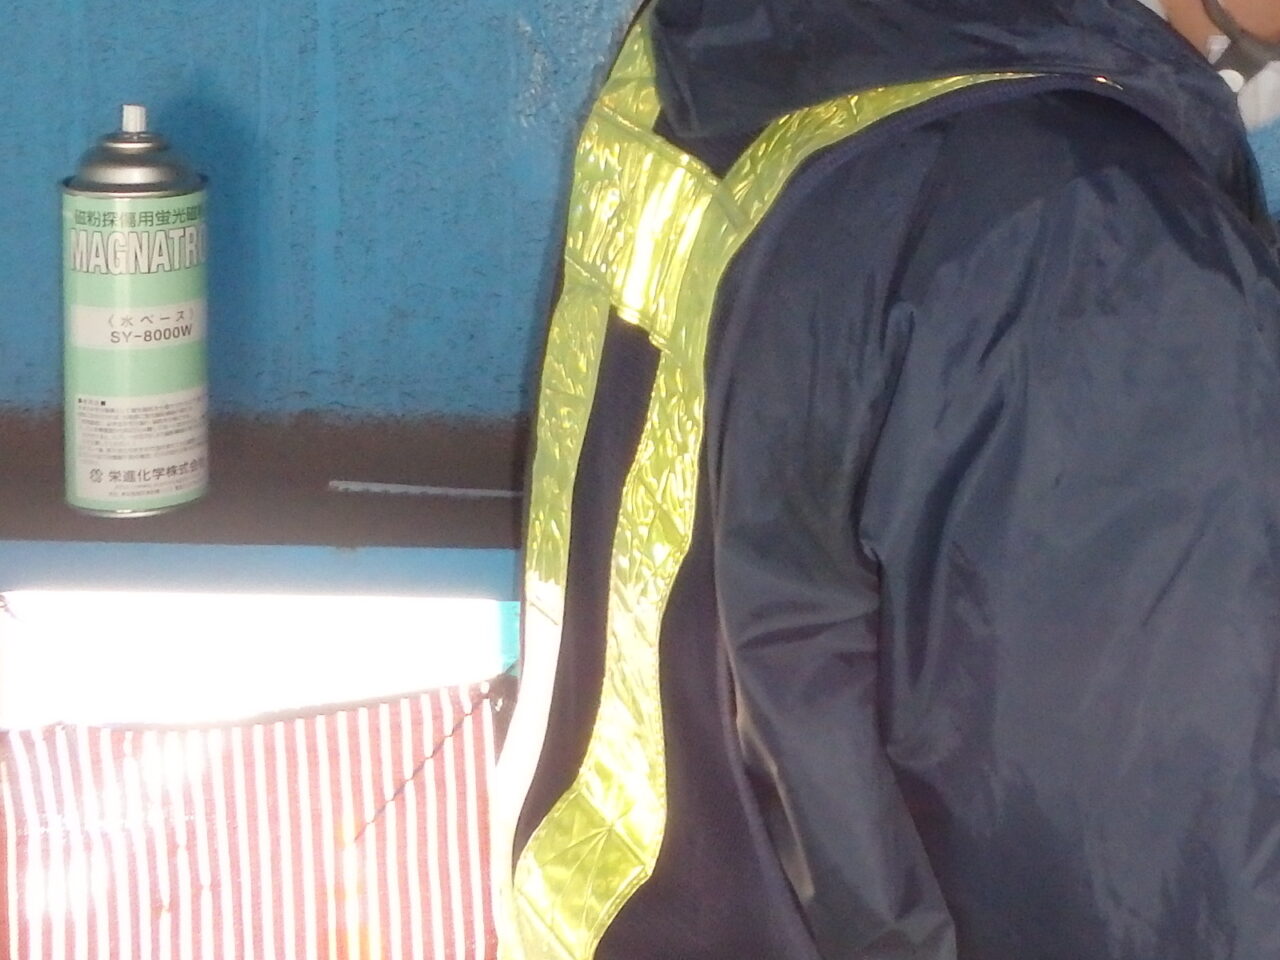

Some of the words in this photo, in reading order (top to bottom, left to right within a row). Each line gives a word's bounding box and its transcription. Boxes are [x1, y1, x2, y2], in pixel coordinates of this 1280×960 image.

[75, 204, 203, 228] 磁粉探傷用蛍光磁
[110, 324, 193, 344] SY-8000W
